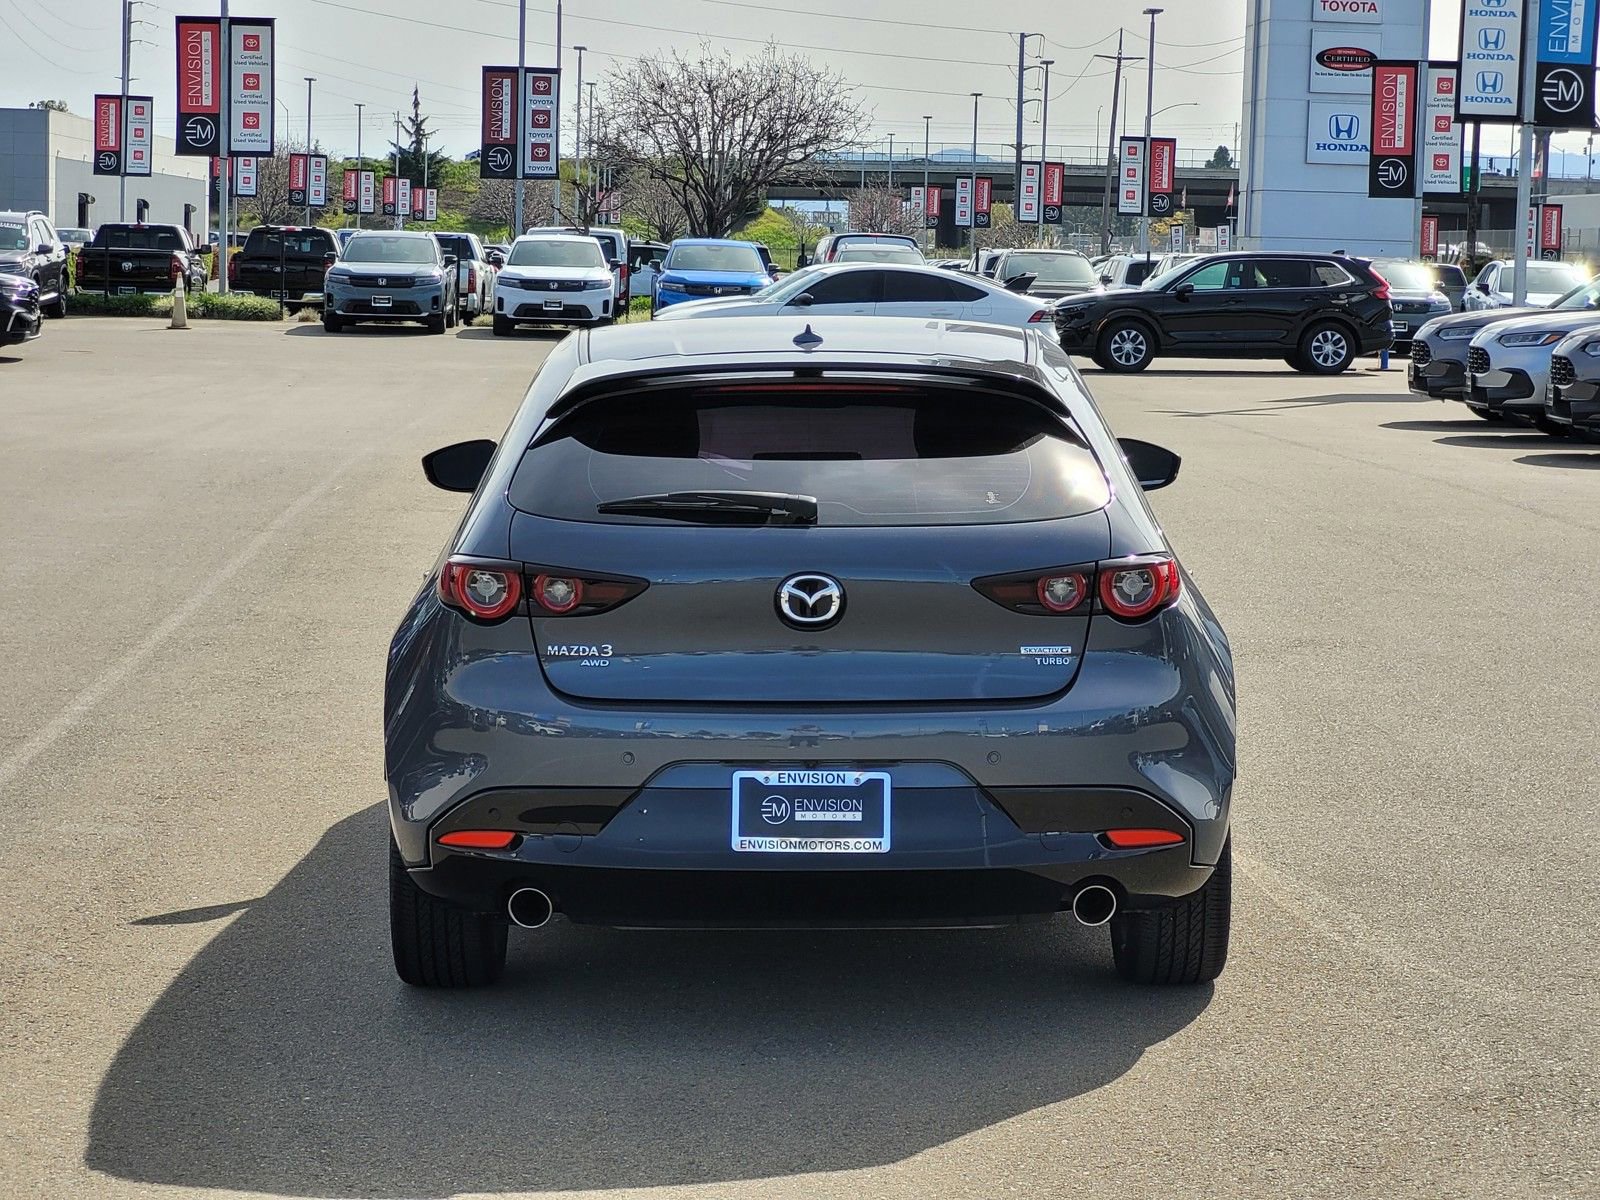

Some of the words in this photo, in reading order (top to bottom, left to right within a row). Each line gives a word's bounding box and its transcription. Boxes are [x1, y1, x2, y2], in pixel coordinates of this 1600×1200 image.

[1320, 0, 1378, 14] TOYOTA
[1469, 9, 1518, 18] HONDA
[1548, 0, 1570, 53] ENVI
[1323, 54, 1370, 63] CERTIFIED
[1466, 52, 1515, 61] HONDA
[187, 30, 202, 106] ENVISION
[203, 37, 211, 101] MOTORS
[1464, 95, 1513, 104] HONDA
[490, 77, 503, 139] ENVISION
[1381, 73, 1397, 148] ENVISION
[1397, 80, 1405, 142] MOTORS
[100, 102, 109, 147] ENVISION
[1315, 142, 1370, 152] HONDA
[1154, 145, 1164, 189] ENVISION
[580, 659, 610, 667] AWD
[1035, 657, 1070, 665] TURBO
[777, 772, 846, 784] ENVISION
[794, 799, 863, 812] ENVISION
[740, 839, 883, 851] ENVISIONMOTORS.COM
